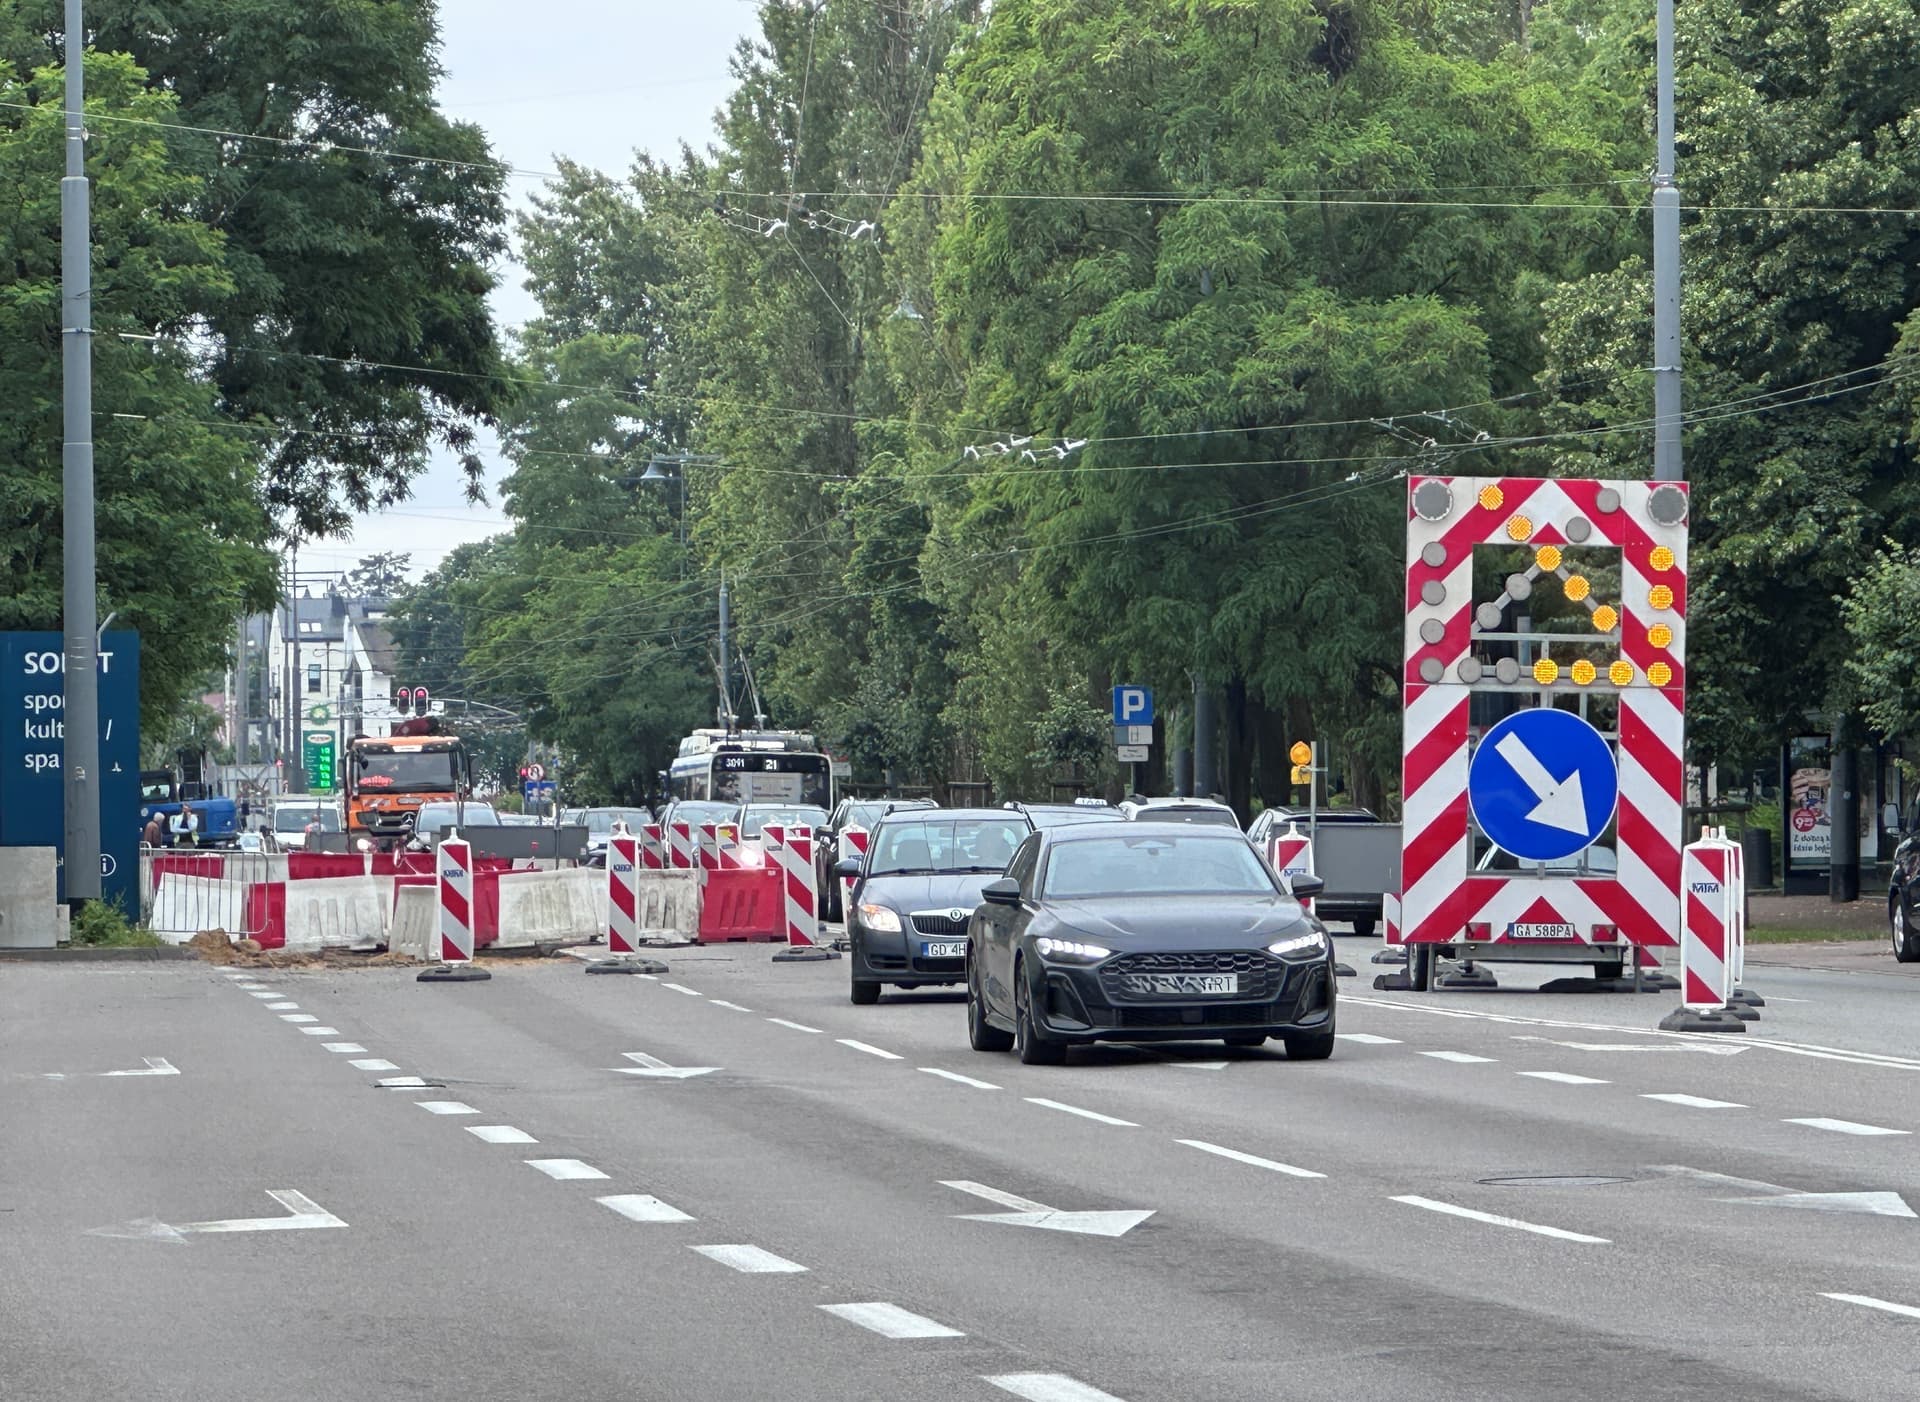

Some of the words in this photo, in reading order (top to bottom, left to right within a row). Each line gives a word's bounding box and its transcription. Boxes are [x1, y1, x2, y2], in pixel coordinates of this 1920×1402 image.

[24, 651, 113, 674] SOT
[24, 694, 65, 714] spo
[1122, 690, 1144, 720] P
[25, 718, 65, 738] kult
[24, 753, 60, 773] spa
[765, 759, 777, 770] 21
[1516, 925, 1531, 936] GA
[1535, 925, 1571, 937] 588PA
[931, 944, 947, 956] GD
[951, 943, 966, 955] 4H
